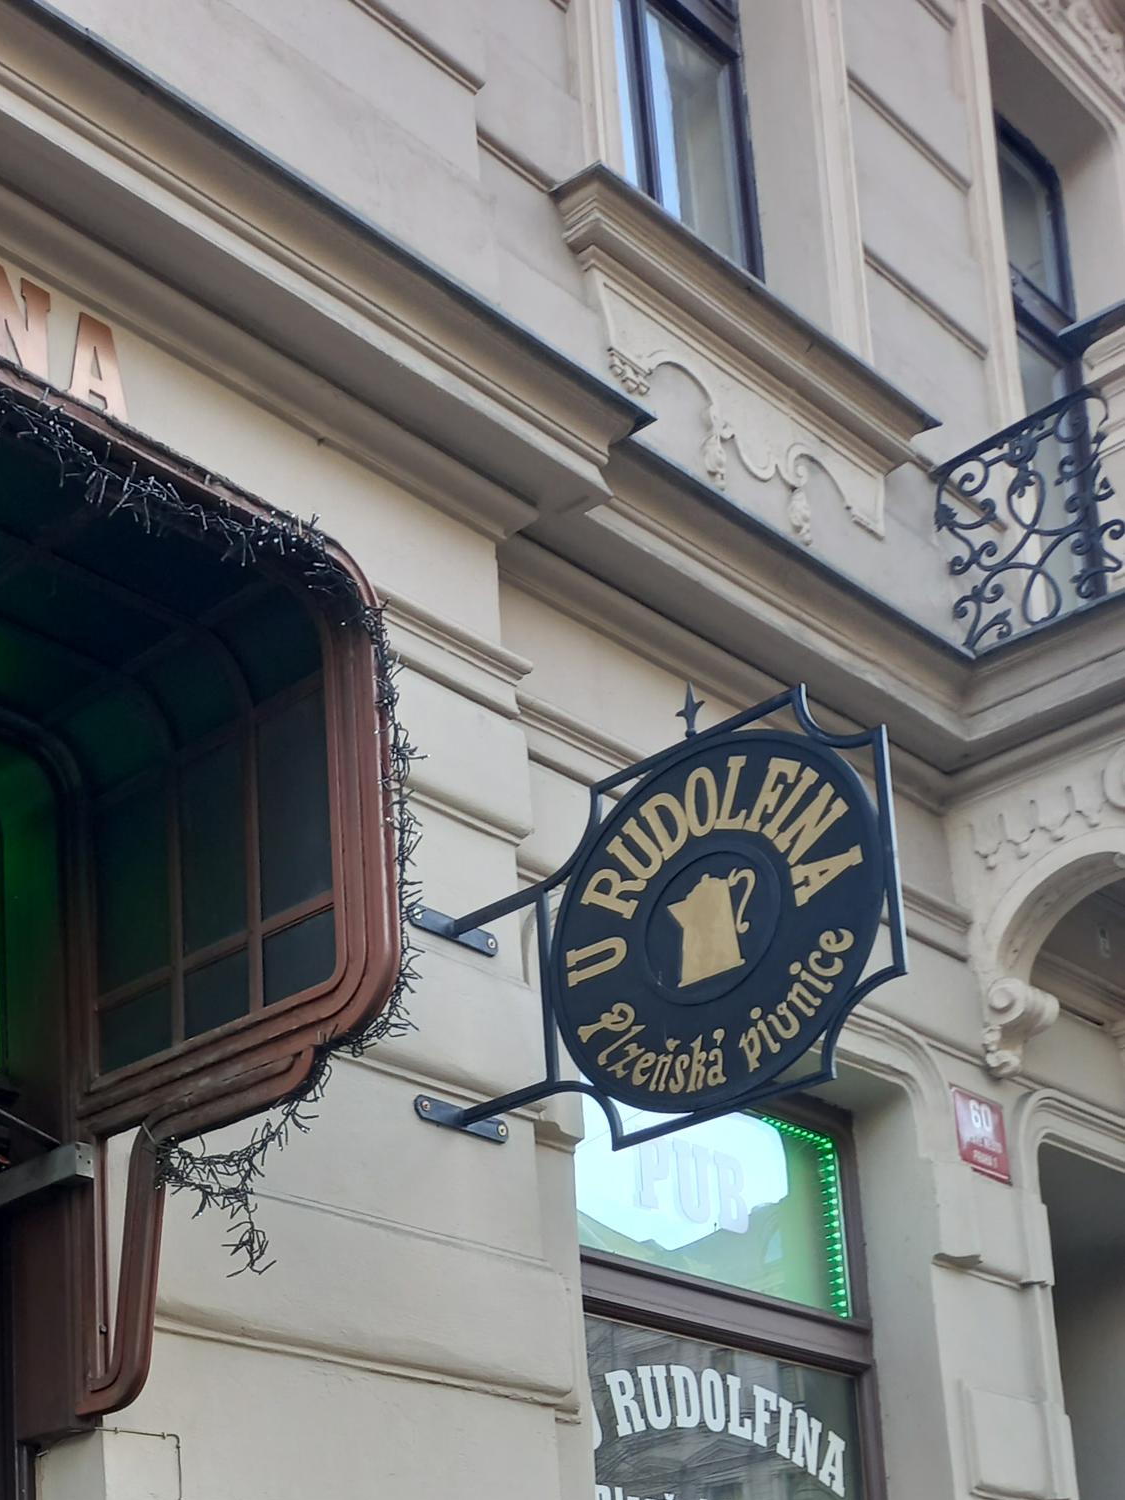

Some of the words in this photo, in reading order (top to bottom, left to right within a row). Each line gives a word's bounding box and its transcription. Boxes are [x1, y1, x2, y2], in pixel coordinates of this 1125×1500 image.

[581, 755, 864, 921] RUDOLFINA
[564, 935, 628, 989] U
[577, 1001, 727, 1095] Plzeňská
[737, 926, 855, 1073] pivnice
[969, 1098, 993, 1132] 60
[632, 1135, 751, 1235] PUB
[605, 1363, 846, 1498] RUDOLFINA
